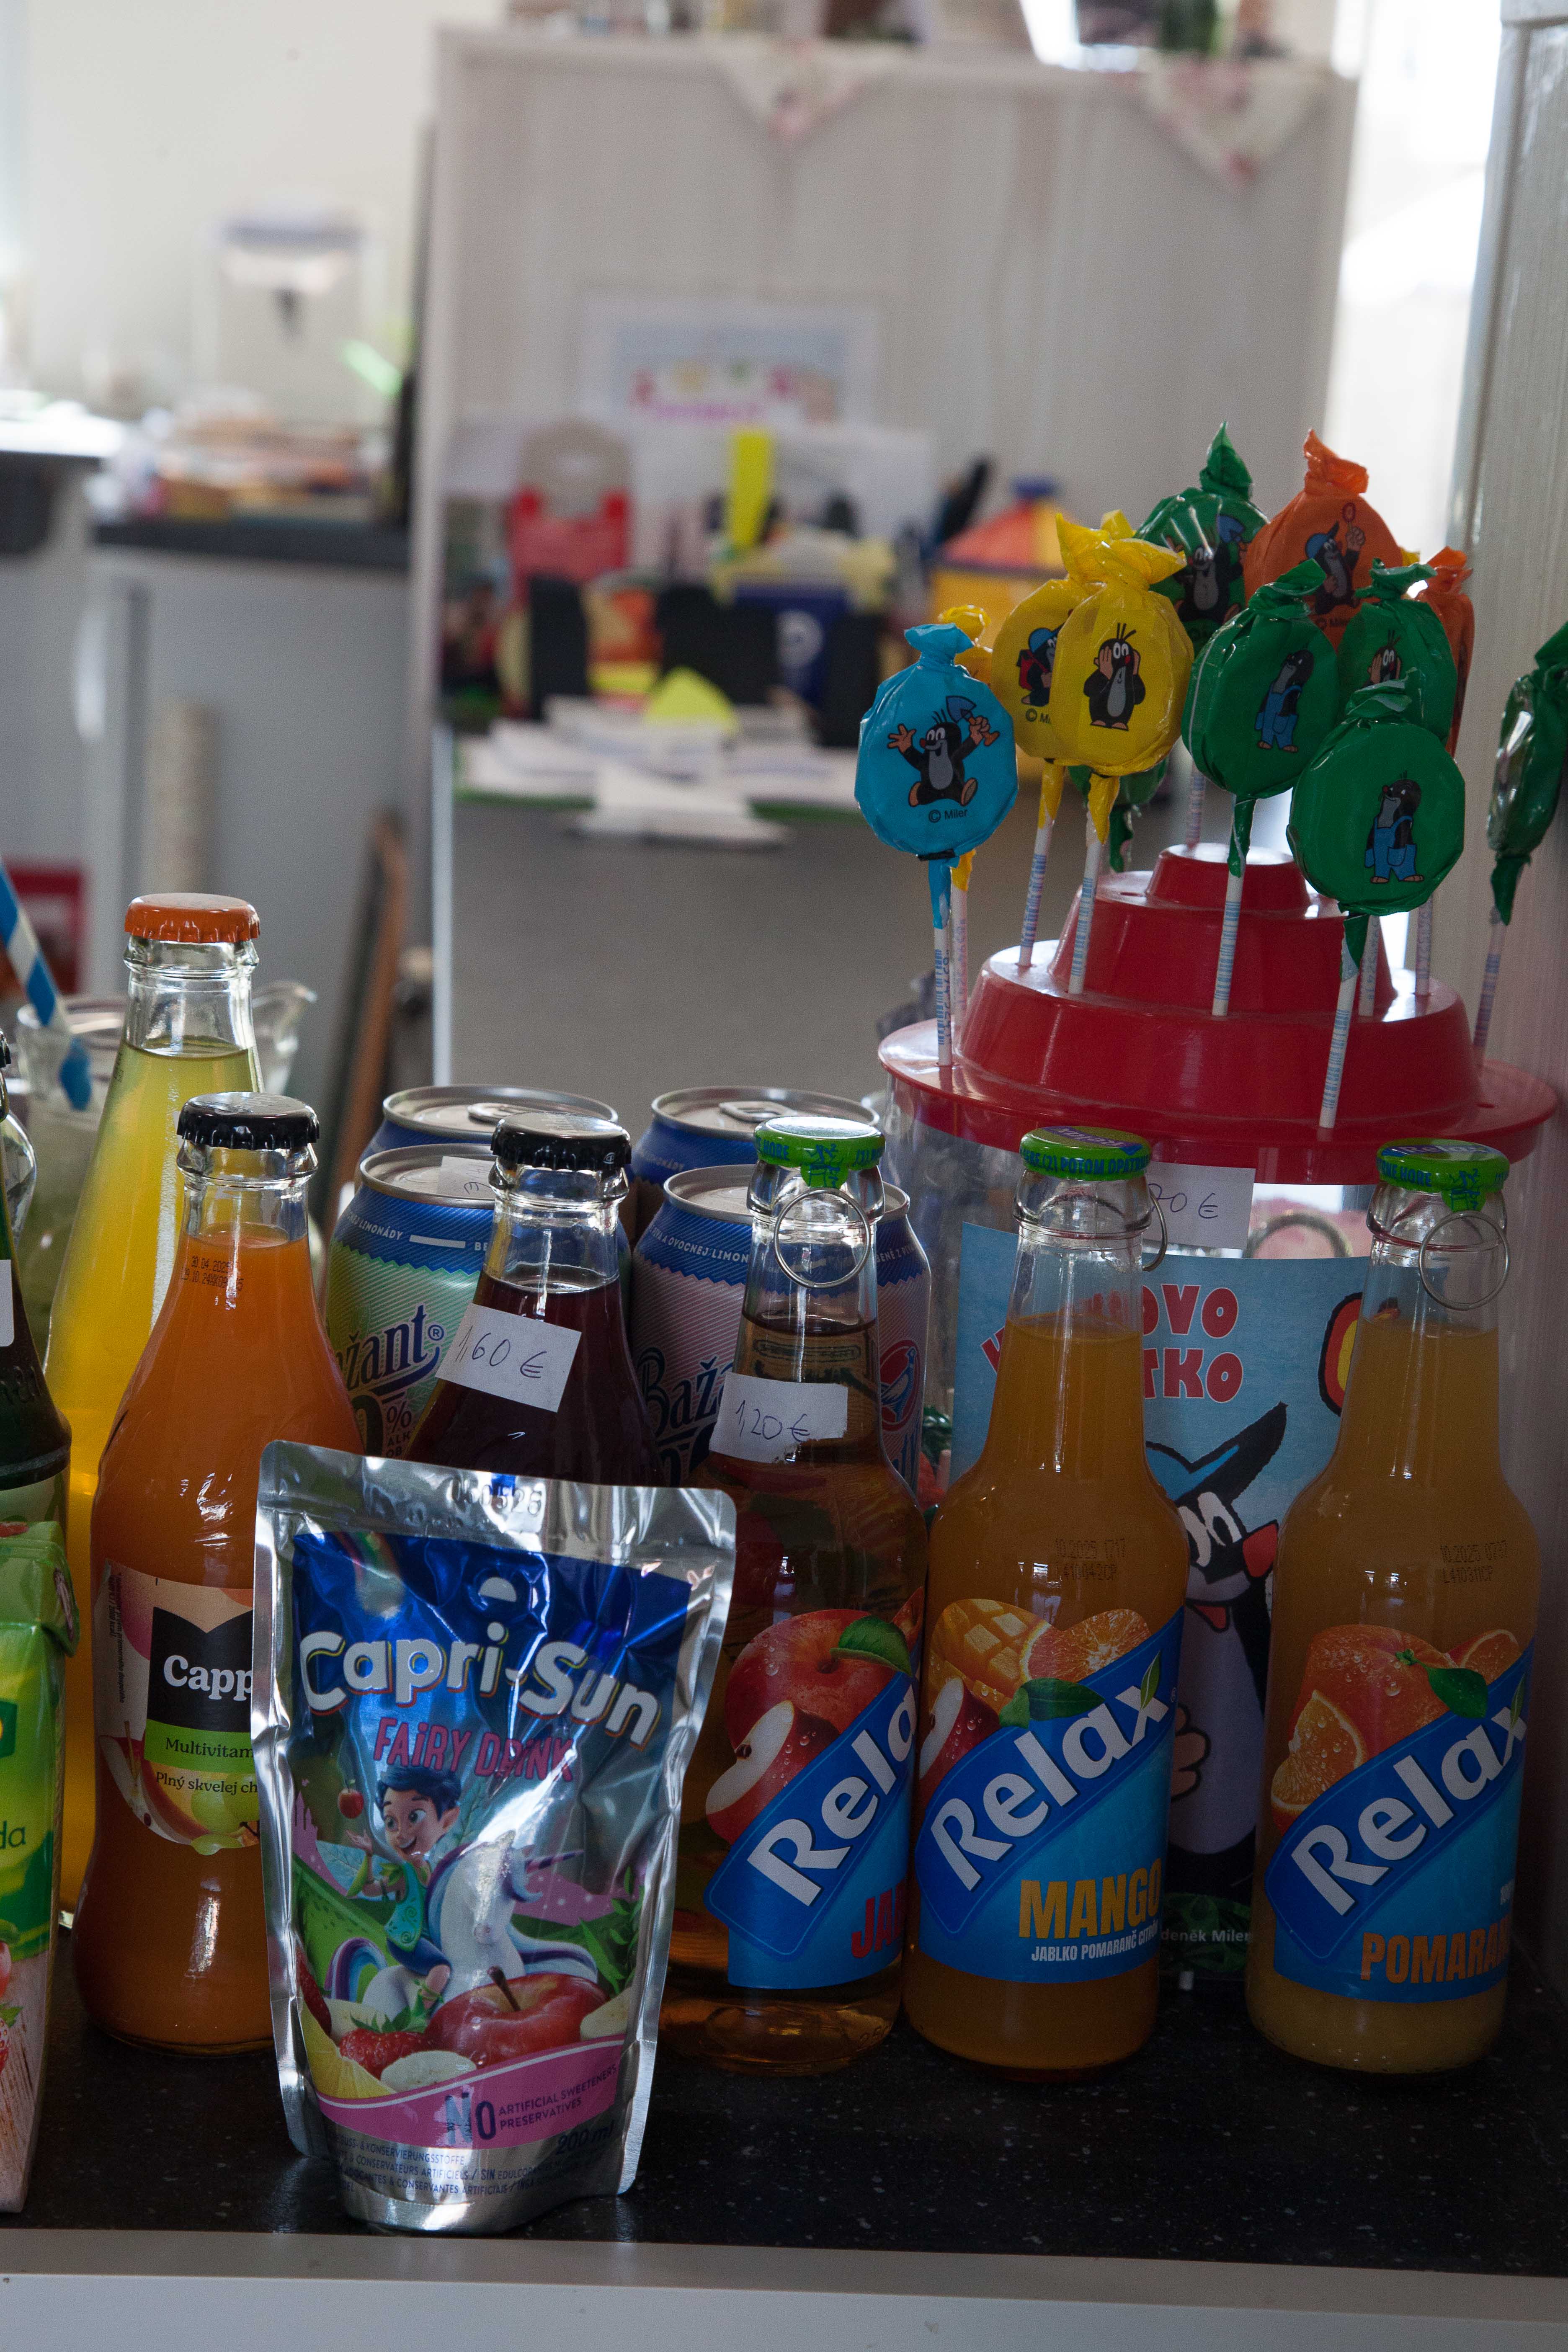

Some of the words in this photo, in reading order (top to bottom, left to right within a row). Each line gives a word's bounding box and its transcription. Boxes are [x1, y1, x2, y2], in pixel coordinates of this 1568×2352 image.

[944, 809, 968, 820] Miler
[1060, 1156, 1105, 1175] POTOM
[1400, 1166, 1431, 1187] HORE
[360, 1219, 404, 1240] LIMONÁDY
[668, 1236, 709, 1256] OVOCNEJ
[712, 1249, 749, 1263] LIMON
[519, 1351, 547, 1379] €
[787, 1413, 810, 1442] €
[164, 1655, 252, 1701] Capp
[299, 1621, 662, 1751] Capri-Sun
[166, 1737, 254, 1758] Multivitam
[156, 1772, 184, 1790] Plný
[188, 1778, 237, 1795] skvelej
[241, 1782, 257, 1793] ch
[930, 1673, 1169, 1892] Relax
[1291, 1700, 1527, 1916] Relax
[1018, 1857, 1162, 1939] MANGO
[1031, 1945, 1078, 1962] JABLKO
[1081, 1929, 1137, 1960] POMARANČ
[445, 2092, 497, 2144] NO
[499, 2094, 559, 2116] ARTIFICIAL
[560, 2064, 617, 2100] SWEETENERS
[500, 2097, 582, 2130] PRESERVATIVES
[366, 2143, 464, 2166] KONSERVIERUNGSSTOFFE
[555, 2129, 589, 2156] 200
[356, 2154, 419, 2175] CONSERVATEURS
[421, 2168, 469, 2180] ARTIFICIELS
[481, 2169, 495, 2180] SIN
[397, 2179, 459, 2195] CONSERVANTES
